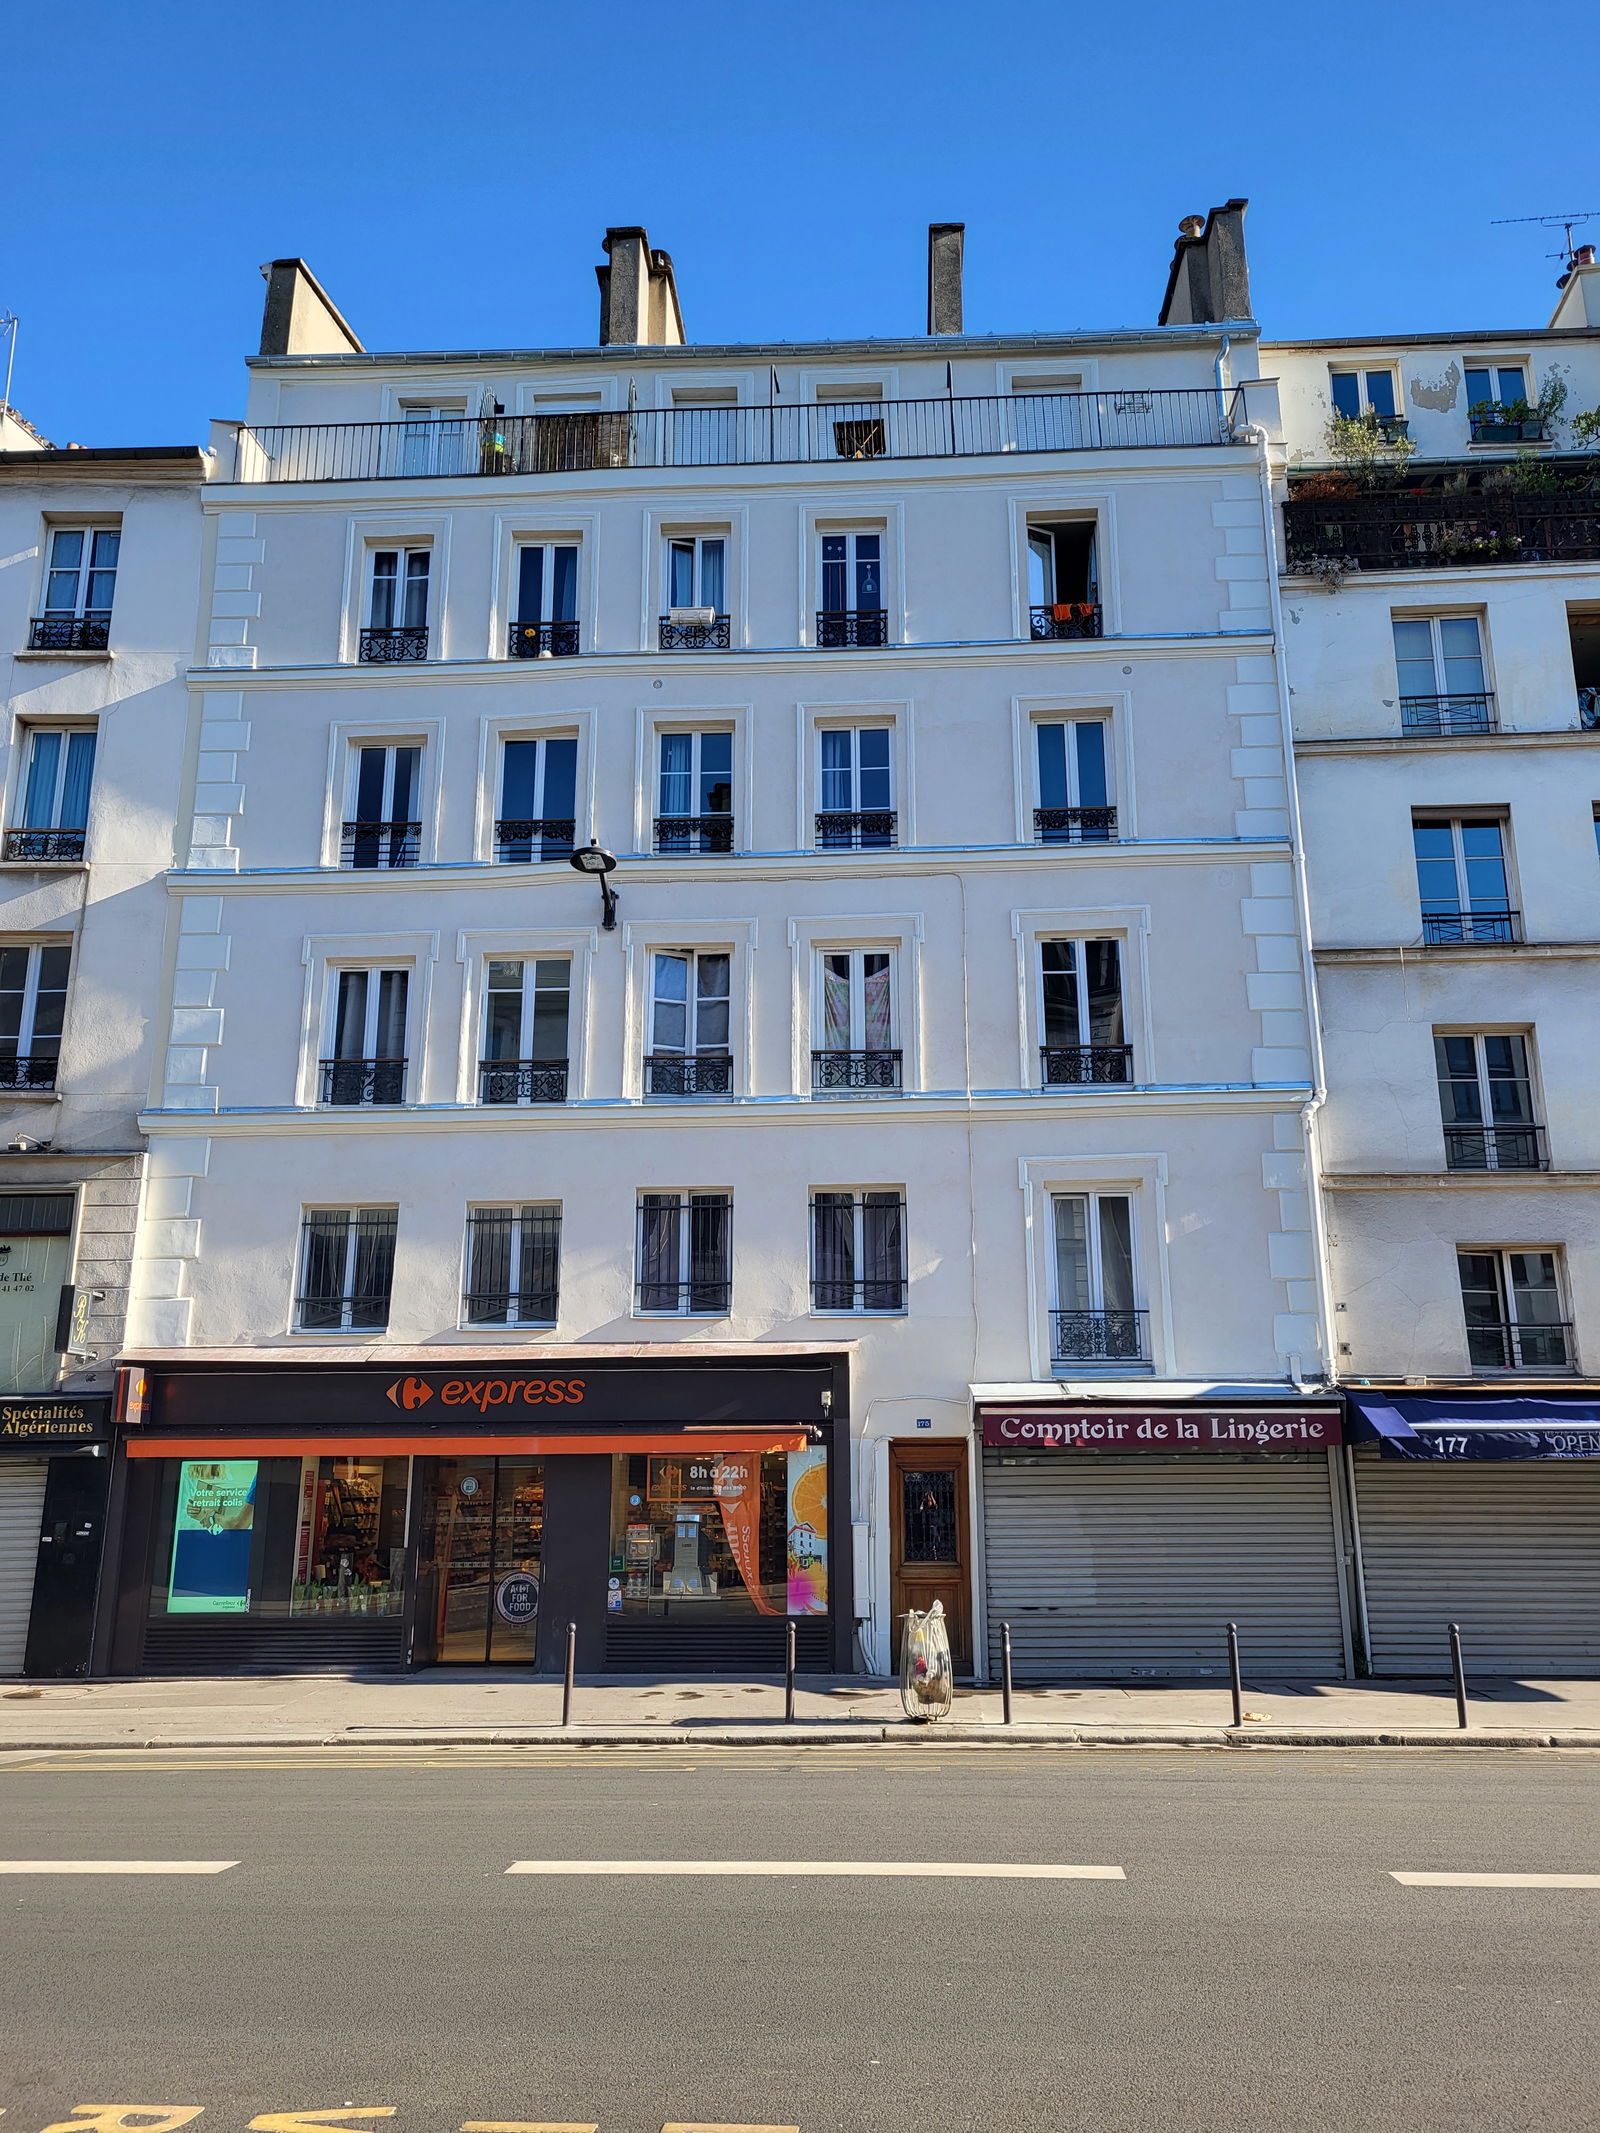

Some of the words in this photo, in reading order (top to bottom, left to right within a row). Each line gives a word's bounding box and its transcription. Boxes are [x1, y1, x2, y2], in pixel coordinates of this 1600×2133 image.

[12, 1271, 33, 1282] Thé
[12, 1285, 24, 1293] 47
[24, 1284, 35, 1292] 02
[441, 1379, 586, 1413] express
[2, 1405, 84, 1423] Spécialités
[1, 1420, 93, 1437] Algériennes
[1000, 1418, 1130, 1444] Comptoir
[1136, 1418, 1169, 1439] de
[1176, 1417, 1199, 1439] la
[1210, 1417, 1325, 1445] Lingerie
[1434, 1436, 1469, 1453] 177
[689, 1465, 707, 1479] 8h
[721, 1465, 748, 1479] 22h
[190, 1488, 215, 1497] Votre
[216, 1488, 248, 1497] service
[193, 1498, 221, 1507] retrait
[222, 1498, 243, 1507] colis
[512, 1594, 528, 1602] FOR
[509, 1602, 530, 1611] FOOD
